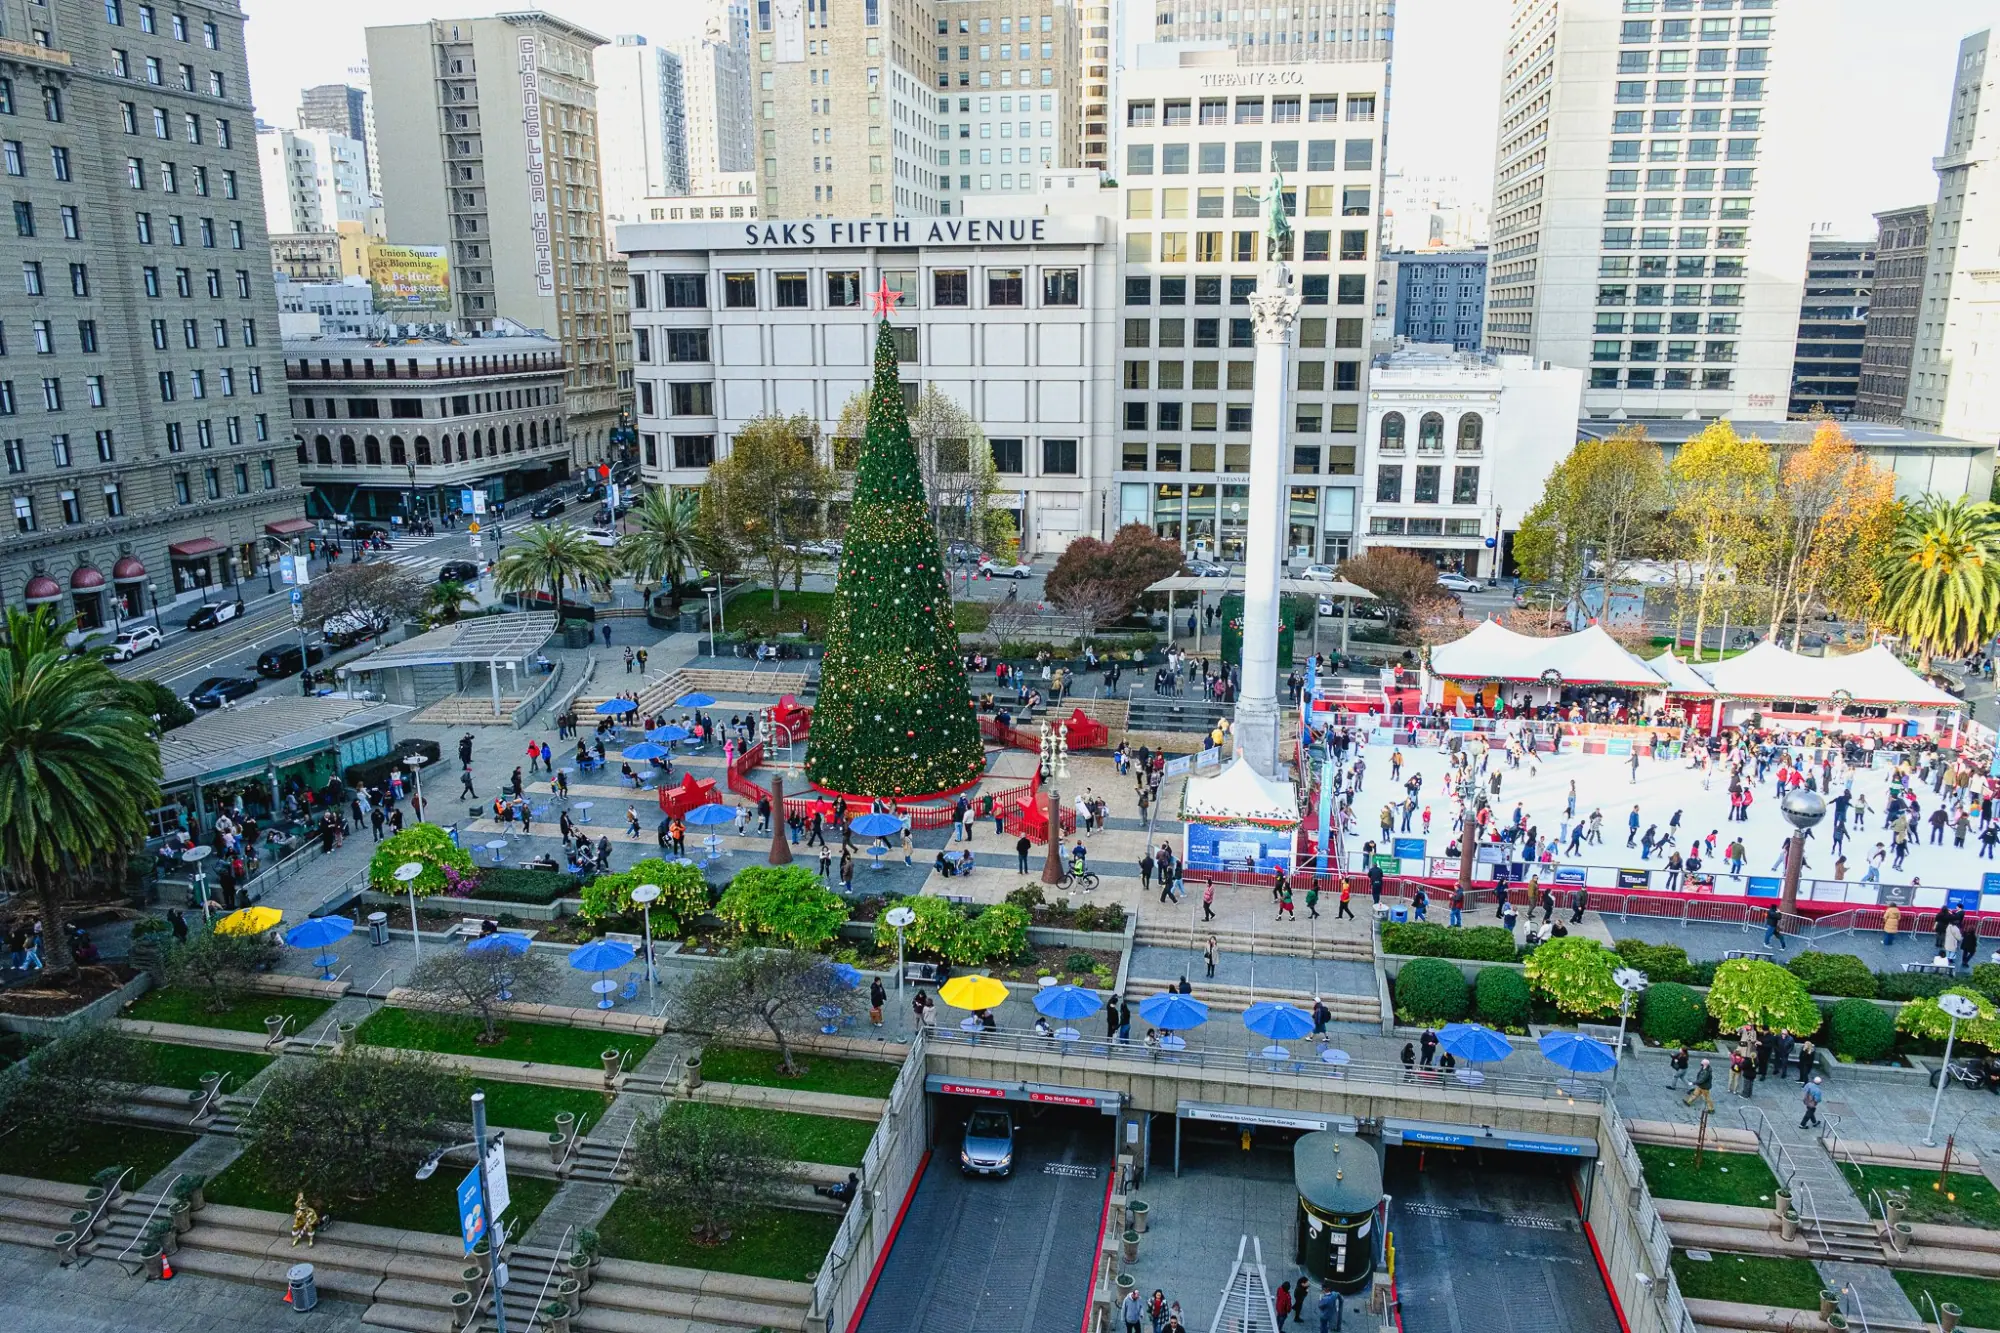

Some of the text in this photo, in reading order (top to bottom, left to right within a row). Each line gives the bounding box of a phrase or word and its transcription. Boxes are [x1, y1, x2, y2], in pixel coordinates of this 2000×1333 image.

[1200, 72, 1265, 87] TIFFANY
[1267, 72, 1278, 85] &
[519, 38, 552, 290] CHANCELLOR HOTEL
[745, 218, 1045, 245] SAKS FIFTH AVENUE
[380, 249, 438, 259] Union Square
[380, 284, 445, 292] 400 Post Street
[1416, 1133, 1444, 1141] Clearance
